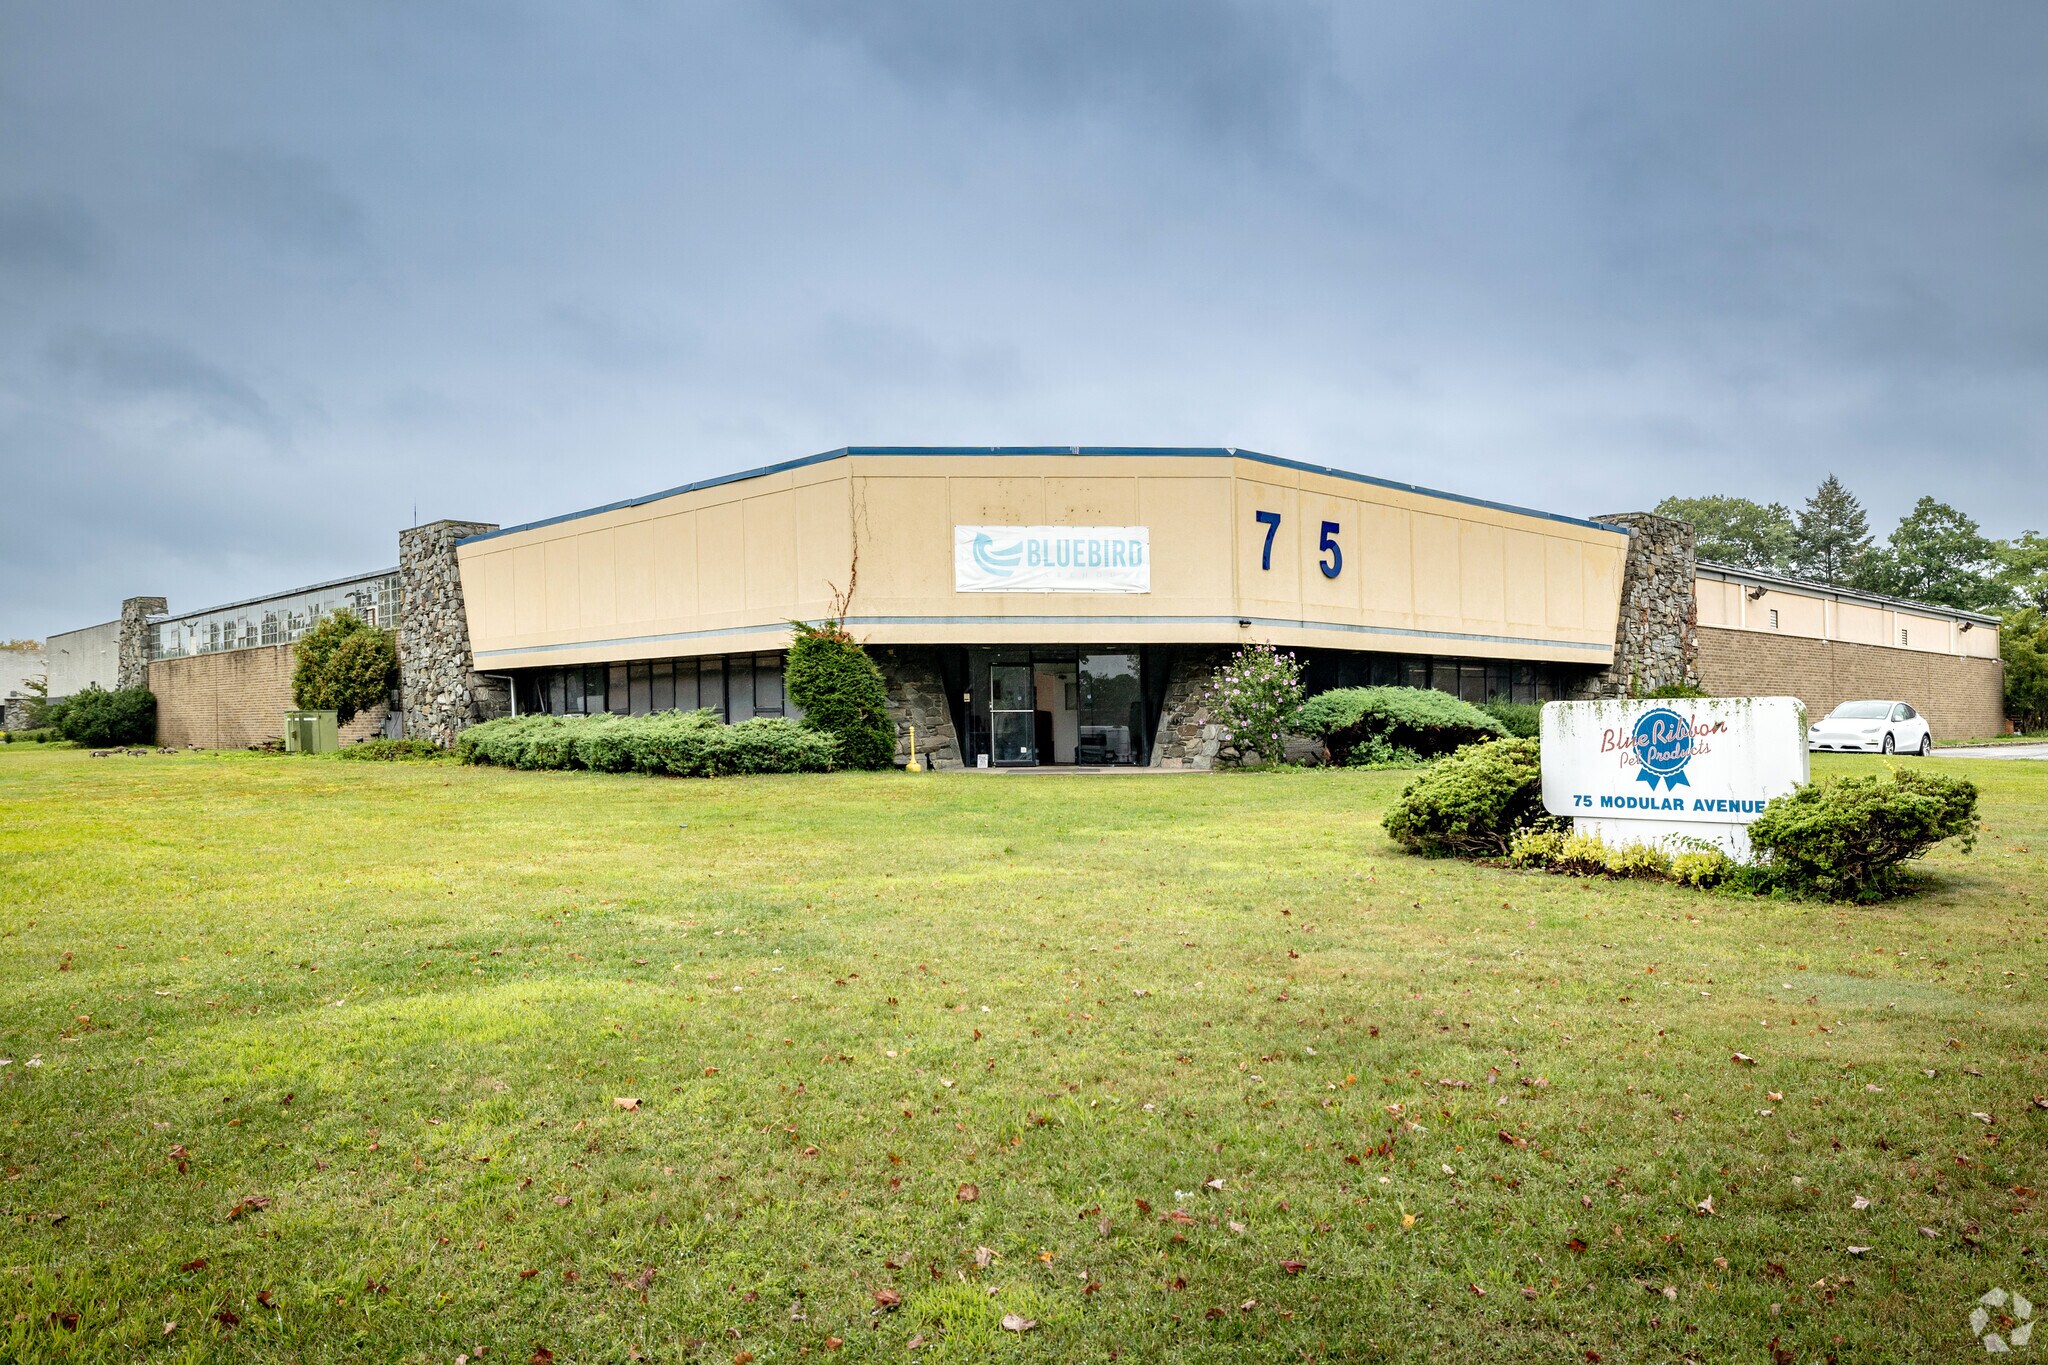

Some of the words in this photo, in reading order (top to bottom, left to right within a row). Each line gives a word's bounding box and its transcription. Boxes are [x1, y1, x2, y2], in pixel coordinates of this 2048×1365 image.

[1028, 538, 1143, 568] BLUEBIRD
[1600, 727, 1650, 753] Blue
[1652, 713, 1728, 744] Ribbon
[1619, 750, 1643, 769] Pet
[1646, 741, 1712, 765] Products
[1573, 795, 1593, 808] 75
[1600, 795, 1684, 811] MODULAR
[1693, 798, 1766, 814] AVENUE
